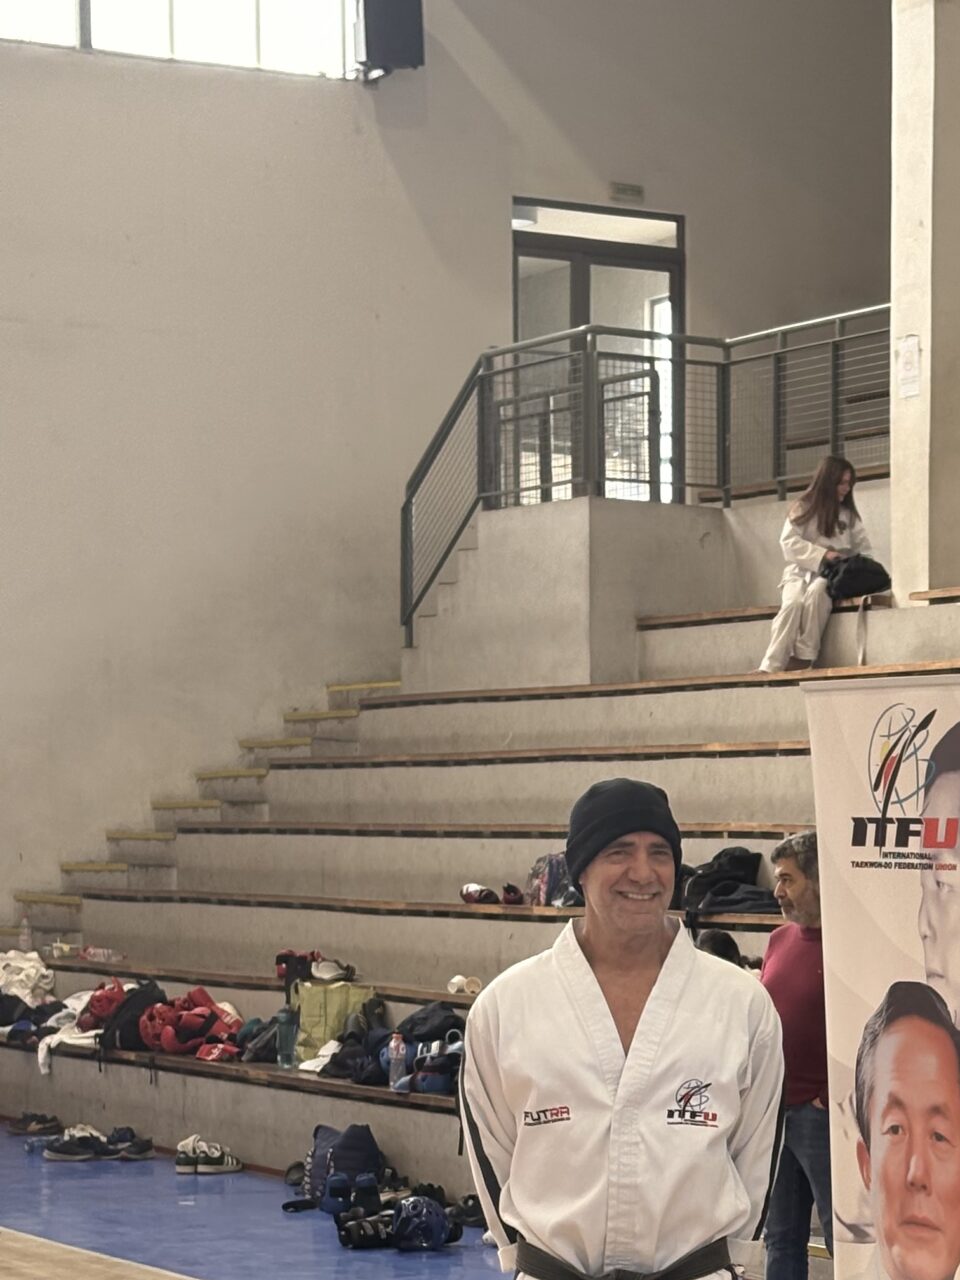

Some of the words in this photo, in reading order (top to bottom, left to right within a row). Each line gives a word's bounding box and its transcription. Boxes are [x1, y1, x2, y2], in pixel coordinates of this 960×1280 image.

[851, 817, 959, 848] ITFU
[882, 851, 933, 860] INTERNATIONAL
[851, 861, 893, 869] TAEKWON-DO
[894, 862, 933, 870] FEDERATION
